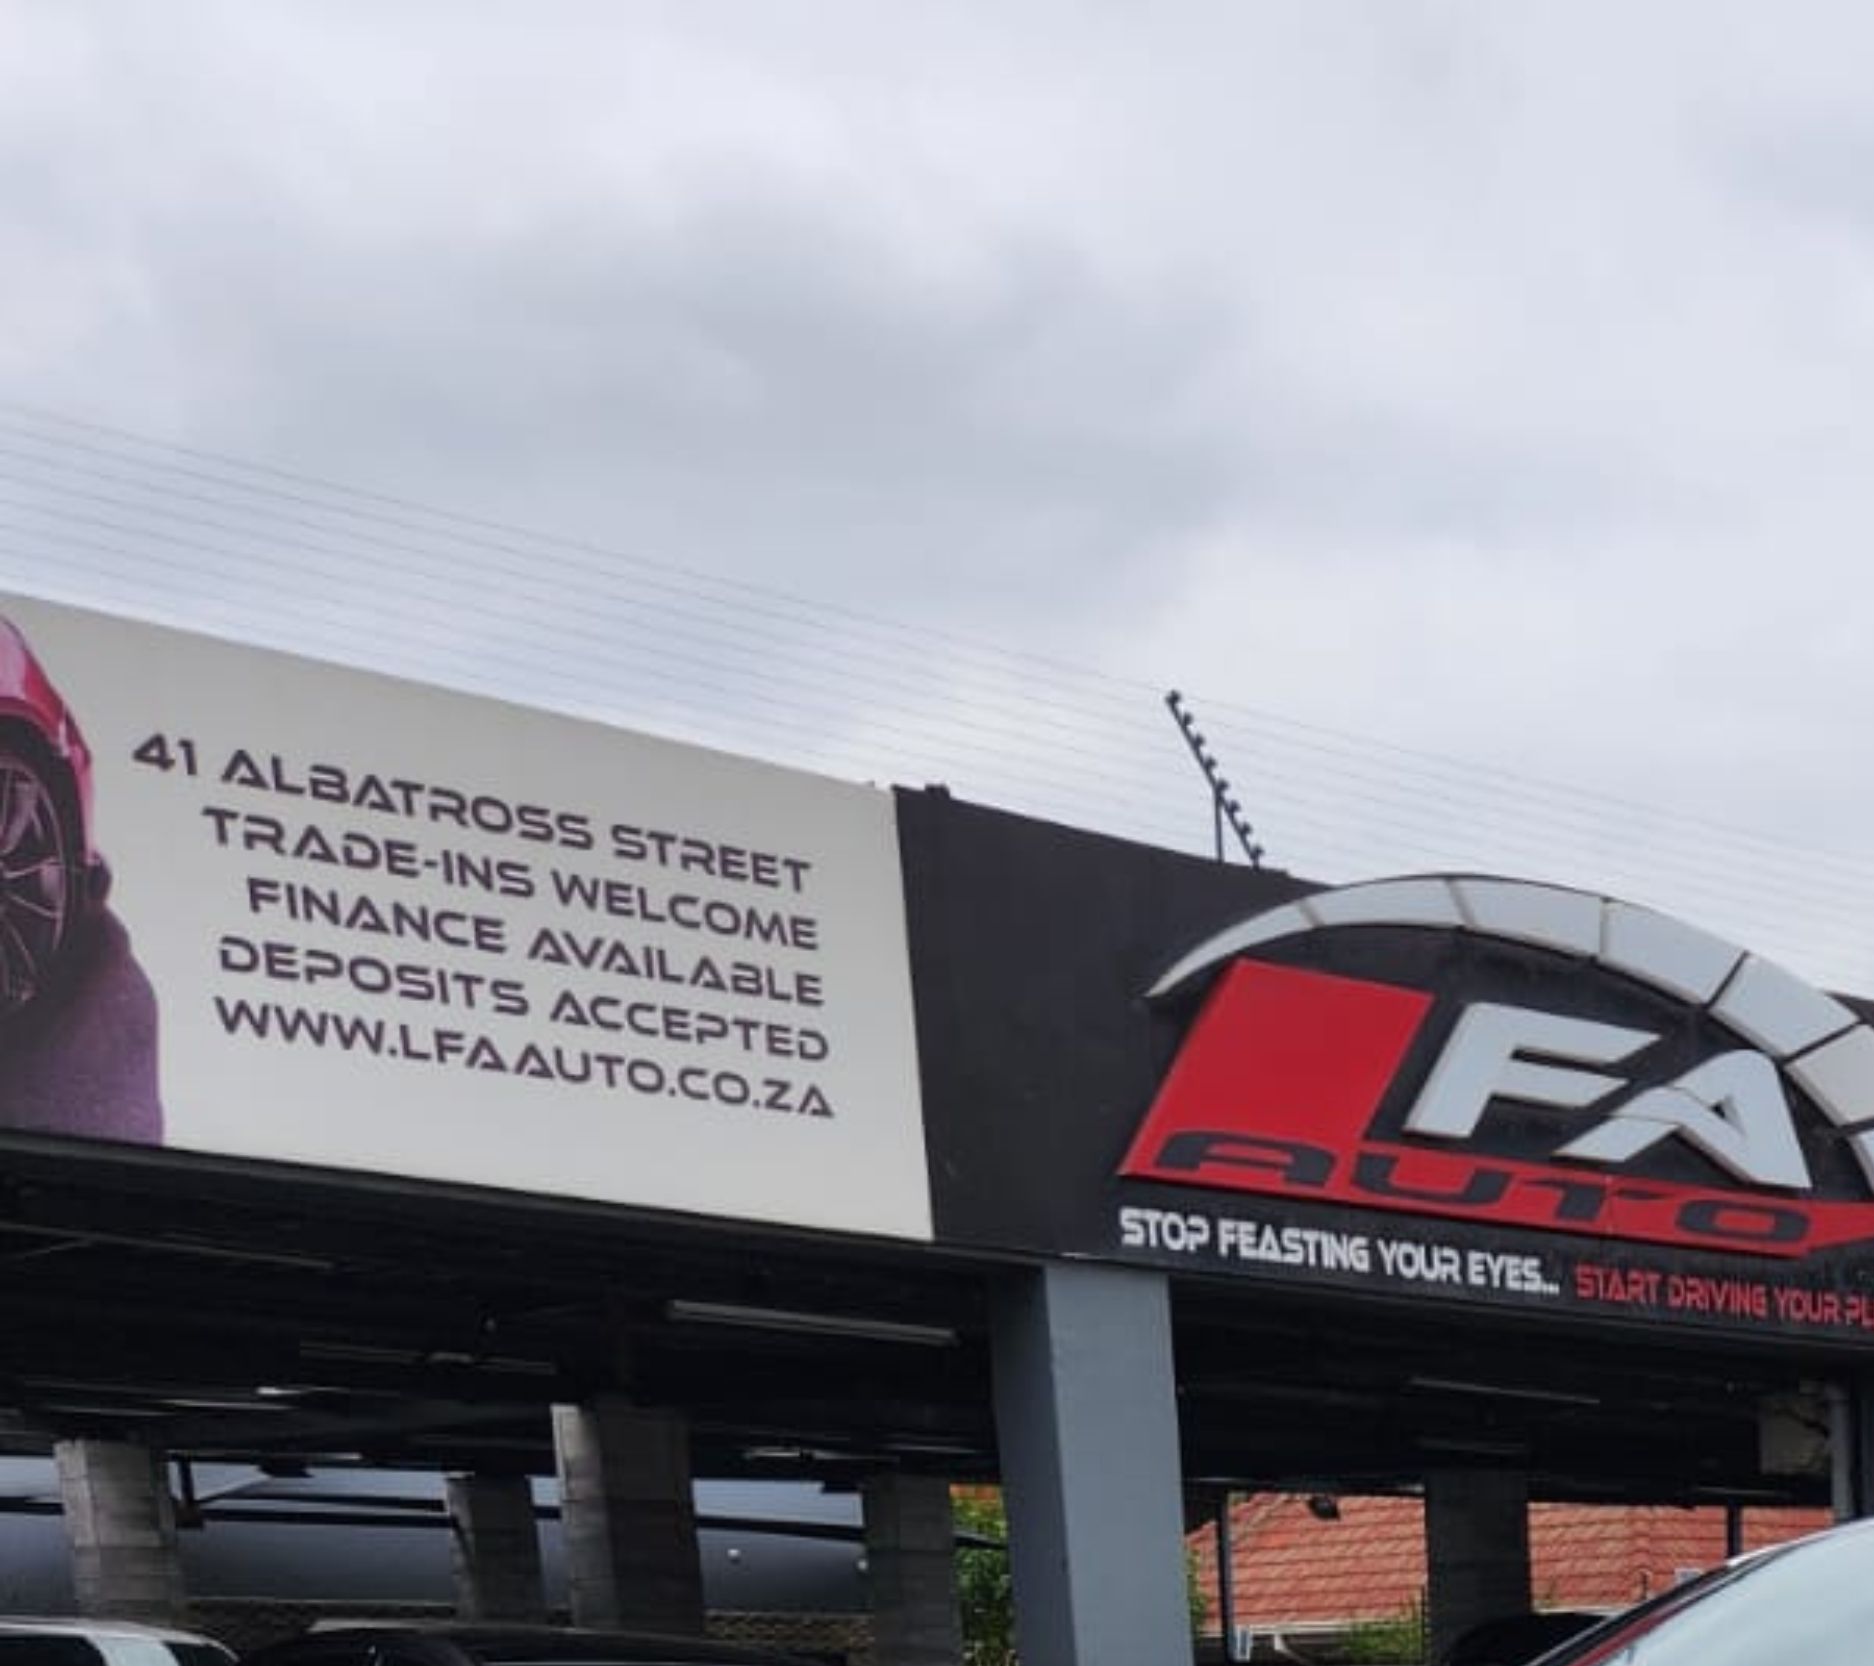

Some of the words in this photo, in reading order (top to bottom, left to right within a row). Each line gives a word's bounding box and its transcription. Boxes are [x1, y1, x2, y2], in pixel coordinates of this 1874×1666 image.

[132, 733, 198, 777] 41
[220, 748, 595, 850] ALBATROSS
[611, 823, 813, 894] STREET
[202, 807, 535, 899] TRADE-INS
[551, 868, 820, 951] WELCOME
[246, 876, 508, 954] FINANCE
[527, 929, 826, 1007] AVAILABLE
[213, 996, 836, 1119] WWW.LFAAUTO.CO.ZA
[218, 935, 530, 1016] DEPOSITS
[549, 989, 830, 1063] ACCEPTED
[1153, 1129, 1811, 1246] AUTO
[1119, 1206, 1210, 1253] STOP
[1217, 1218, 1371, 1273] FEASTING
[1377, 1239, 1463, 1284] YOUR
[1468, 1251, 1561, 1295] EYES...
[1575, 1263, 1661, 1302] START
[1668, 1274, 1768, 1320] DRIVING
[1774, 1286, 1841, 1324] YOUR
